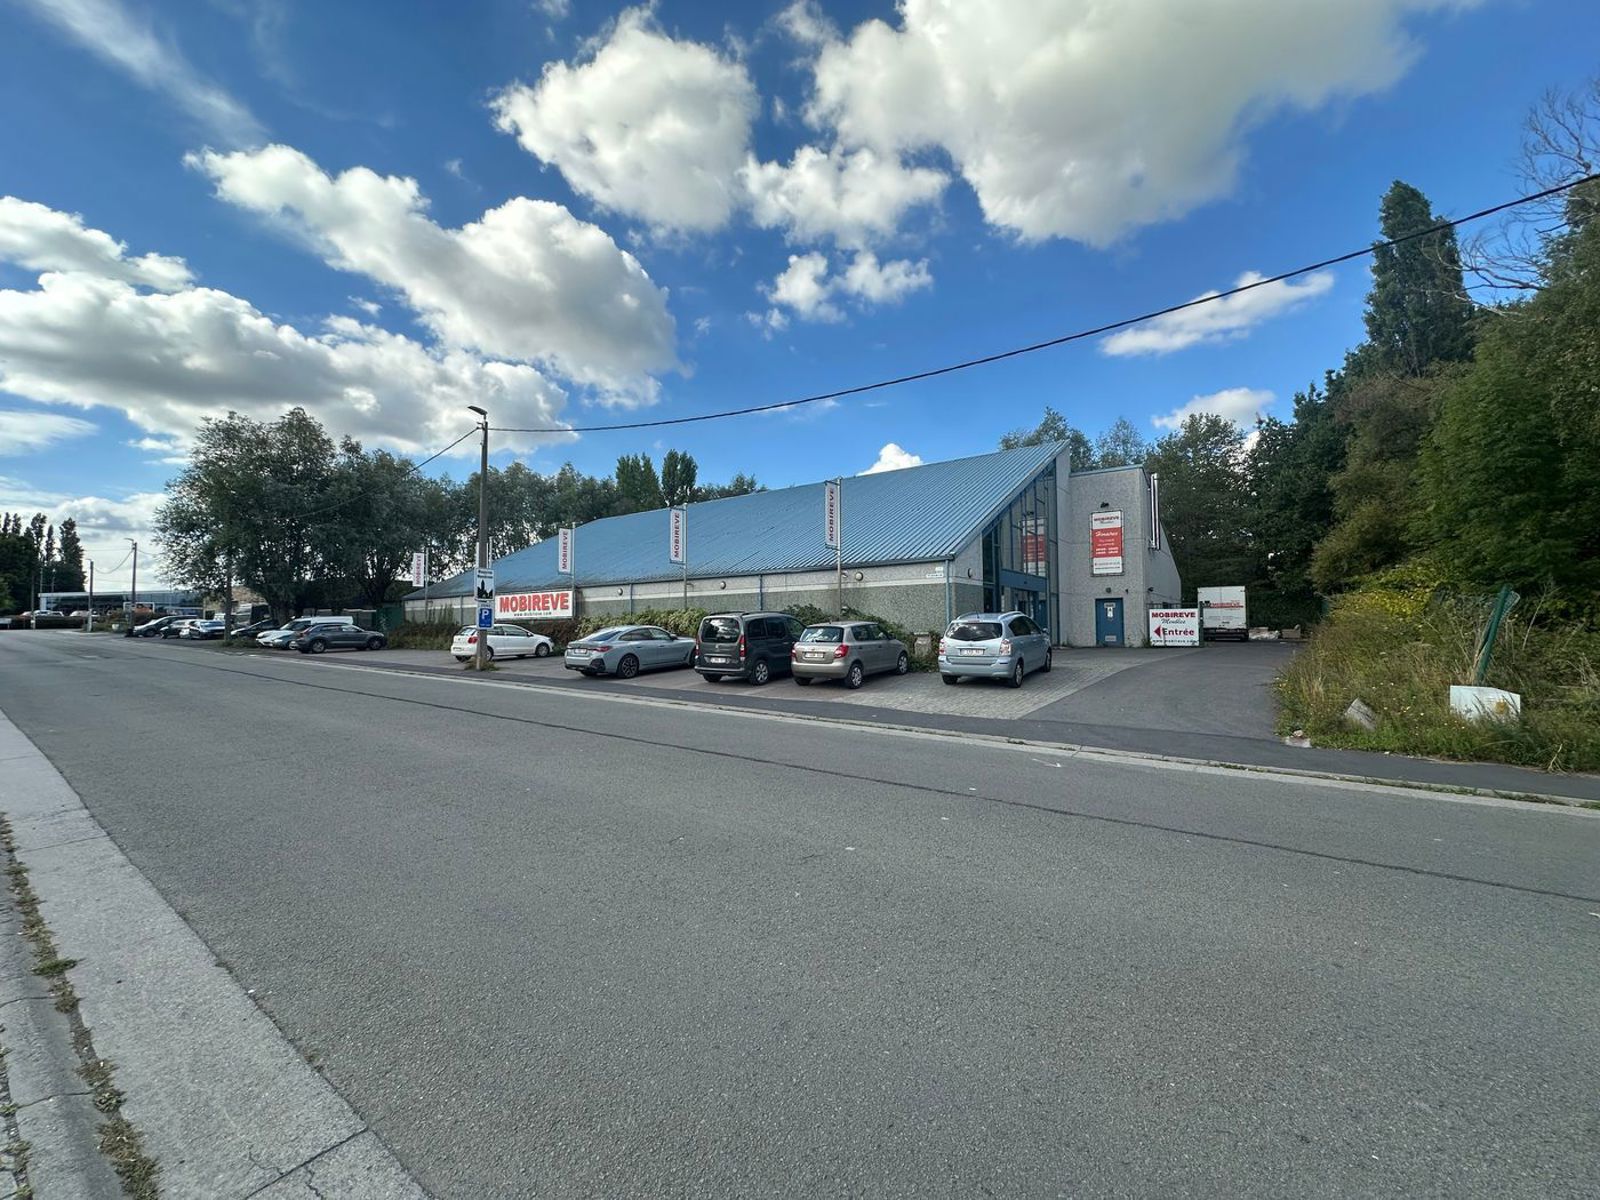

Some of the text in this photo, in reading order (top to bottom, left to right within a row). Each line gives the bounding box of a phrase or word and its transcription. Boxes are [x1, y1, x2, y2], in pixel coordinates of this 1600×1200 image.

[499, 592, 569, 613] MOBIREVE
[482, 609, 489, 620] P
[1162, 627, 1195, 636] Entrée
